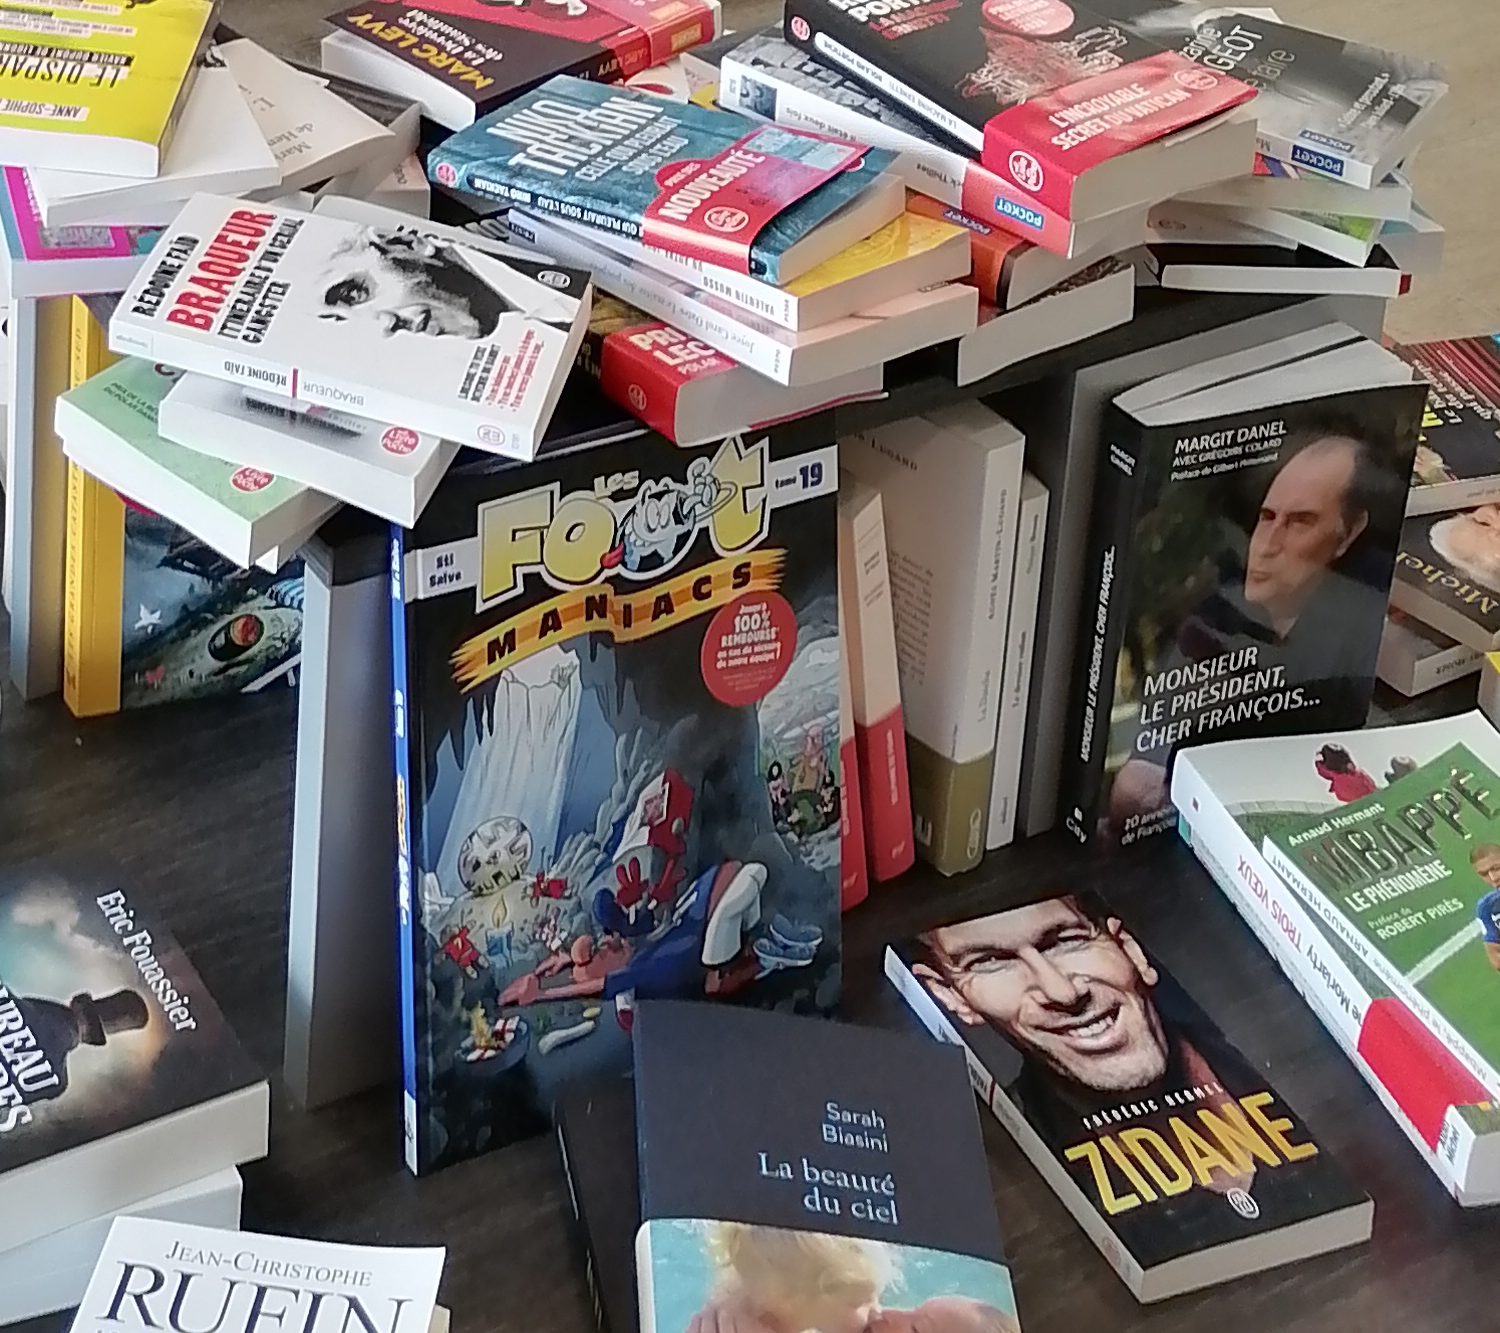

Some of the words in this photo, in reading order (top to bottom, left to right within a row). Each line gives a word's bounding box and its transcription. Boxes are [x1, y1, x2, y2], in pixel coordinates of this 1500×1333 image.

[347, 12, 420, 48] LEVY
[89, 65, 123, 89] LE
[411, 47, 495, 91] MARC
[2, 98, 82, 120] ANNE-SOPHIE
[1048, 82, 1152, 129] L'INCROYABLE
[1050, 121, 1109, 152] SECRET
[1128, 88, 1193, 126] VATICAN
[510, 96, 666, 176] TACKIAN
[1292, 144, 1343, 176] POCKET
[658, 147, 767, 222] NOUVEAUTÉ
[994, 195, 1045, 231] POCKET
[166, 208, 277, 332] BRAQUEUR
[241, 279, 292, 345] GANGSTER
[302, 380, 365, 406] BRAQUEUR
[1174, 427, 1235, 457] MARGIT
[1236, 418, 1288, 444] DANEL
[593, 468, 641, 498] Les
[799, 462, 824, 487] 19
[486, 559, 752, 668] MANIACS
[732, 609, 772, 633] 100%
[1139, 695, 1168, 726] LE
[1169, 663, 1288, 720] PRÉSIDENT,
[1143, 645, 1259, 698] MONSIEUR
[1135, 717, 1192, 754] CHER
[1196, 688, 1323, 743] FRANÇOIS...
[1288, 818, 1332, 848] Arnaud
[1332, 802, 1386, 829] Hermant
[1272, 852, 1327, 910] HERMANT
[1344, 890, 1375, 915] LE
[1372, 858, 1453, 906] PHÉNOMÈNE
[1270, 896, 1303, 955] TROIS
[1376, 917, 1420, 942] ROBERT
[1420, 896, 1465, 924] PIRÈS
[124, 926, 199, 1035] Fouassier
[822, 1100, 887, 1131] Sarah
[820, 1123, 891, 1156] Biasini
[1064, 1092, 1318, 1219] ZIDANE
[759, 1151, 795, 1182] La
[801, 1157, 899, 1198] beauté
[801, 1187, 843, 1217] du
[847, 1189, 901, 1225] ciel
[164, 1239, 375, 1290] JEAN-CHRISTOPHE
[95, 1256, 434, 1333] RUFIN
